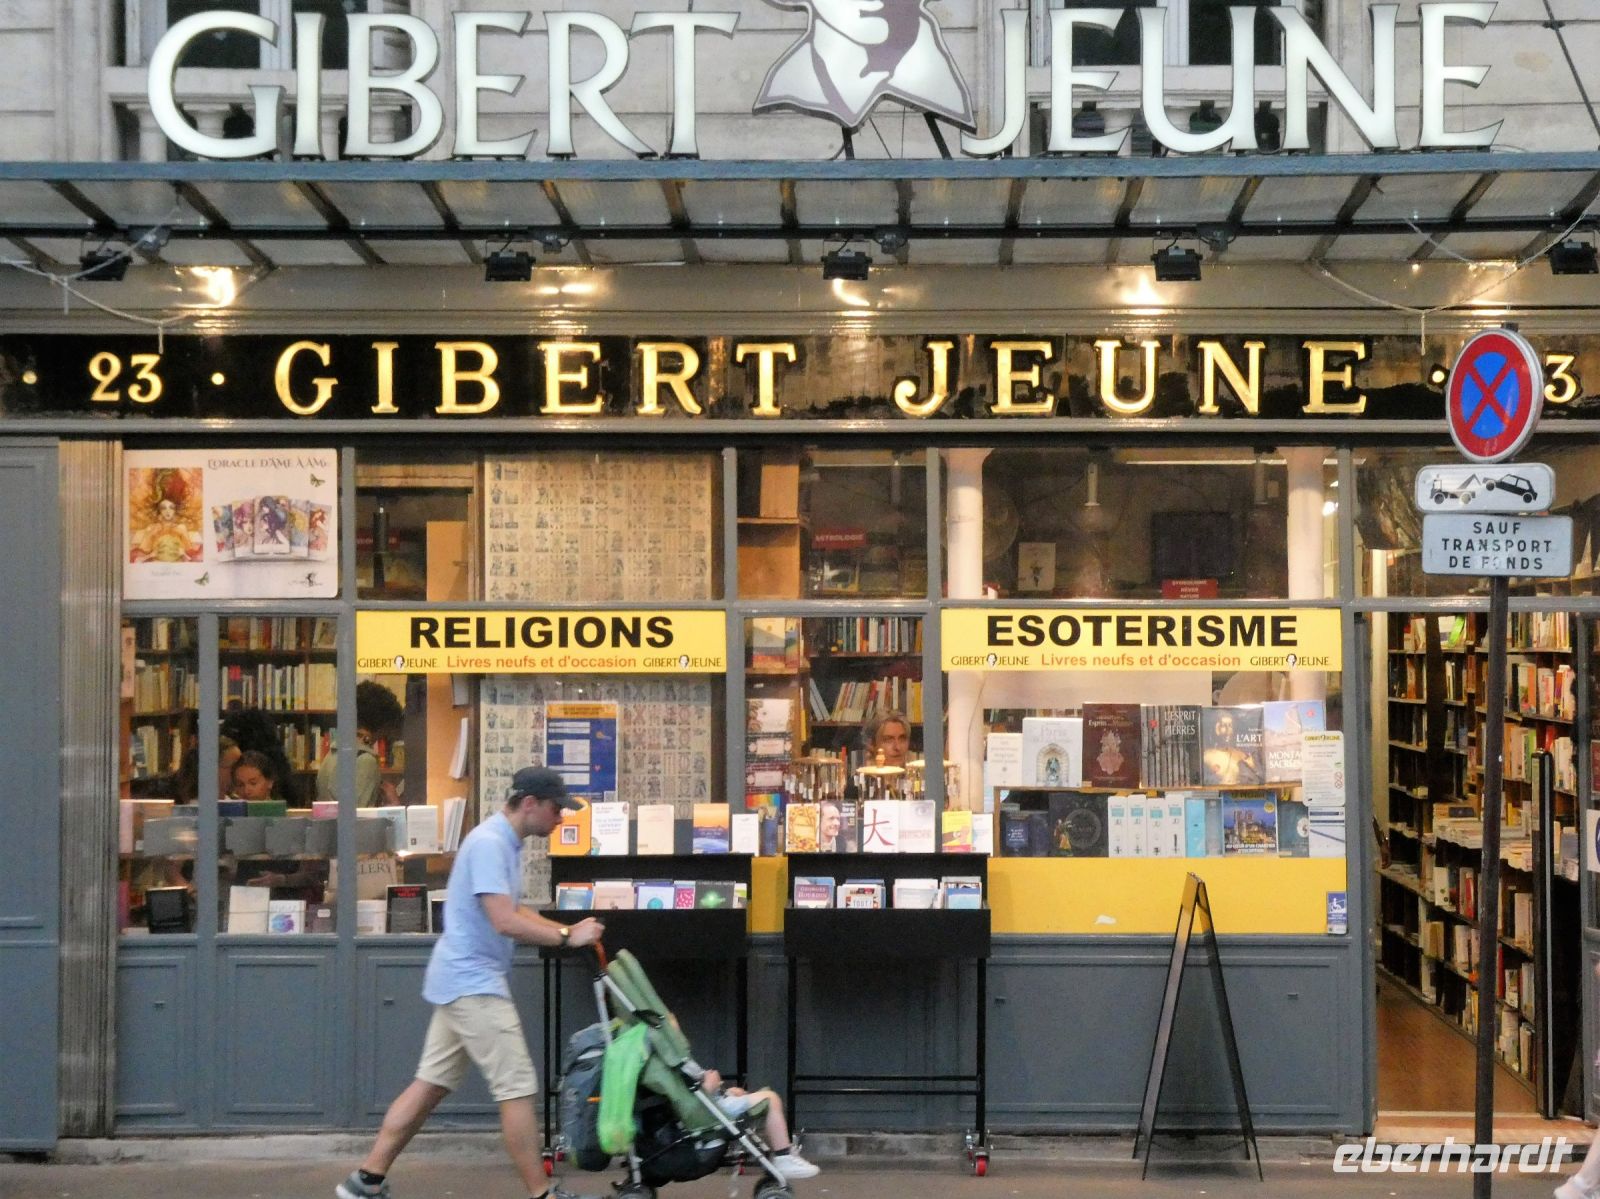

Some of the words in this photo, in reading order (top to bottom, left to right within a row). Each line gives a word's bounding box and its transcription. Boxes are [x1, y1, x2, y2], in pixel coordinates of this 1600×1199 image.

[148, 10, 741, 159] GIBERT
[961, 2, 1505, 155] JEUNE
[88, 351, 164, 403] 23
[274, 341, 797, 416] GIBERT
[894, 339, 1367, 415] JEUNE
[1543, 354, 1579, 405] 3
[1473, 521, 1522, 535] SAUF
[1441, 538, 1552, 553] TRANSPORT
[1449, 555, 1471, 569] DE
[411, 616, 674, 649] RELIGIONS
[986, 614, 1298, 647] ESOTERISME
[357, 656, 394, 669] GIBERT
[404, 656, 438, 669] JEUNE
[446, 655, 492, 669] Livres
[495, 655, 536, 669] neufs
[540, 656, 555, 669] et
[558, 655, 637, 669] d'occasion
[642, 656, 678, 669] GIBERT
[688, 656, 722, 669] JEUNE
[951, 655, 985, 667] GIBERT
[998, 655, 1030, 667] JEUNE
[1040, 653, 1087, 667] Livres
[1092, 653, 1135, 667] neufs
[1139, 654, 1153, 667] et
[1157, 652, 1241, 667] d'occasion
[1249, 655, 1285, 667] GIBERT
[1298, 655, 1330, 667] JEUNE
[1236, 733, 1263, 743] L'ART
